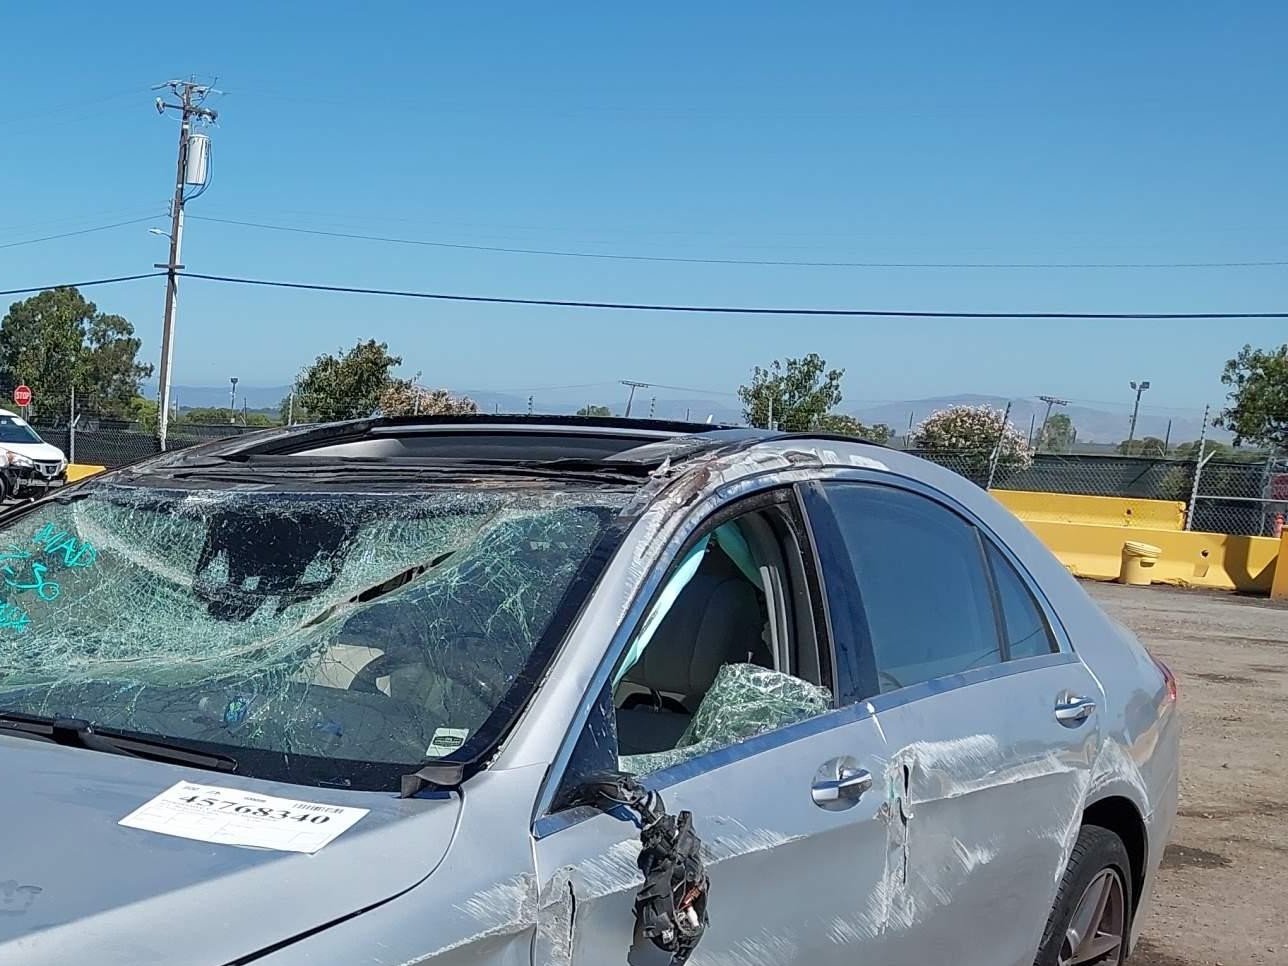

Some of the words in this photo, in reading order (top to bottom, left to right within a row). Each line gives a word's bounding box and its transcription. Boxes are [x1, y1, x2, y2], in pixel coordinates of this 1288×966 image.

[16, 391, 30, 400] STOP
[33, 522, 97, 567] MAD
[179, 795, 331, 826] 45768340
